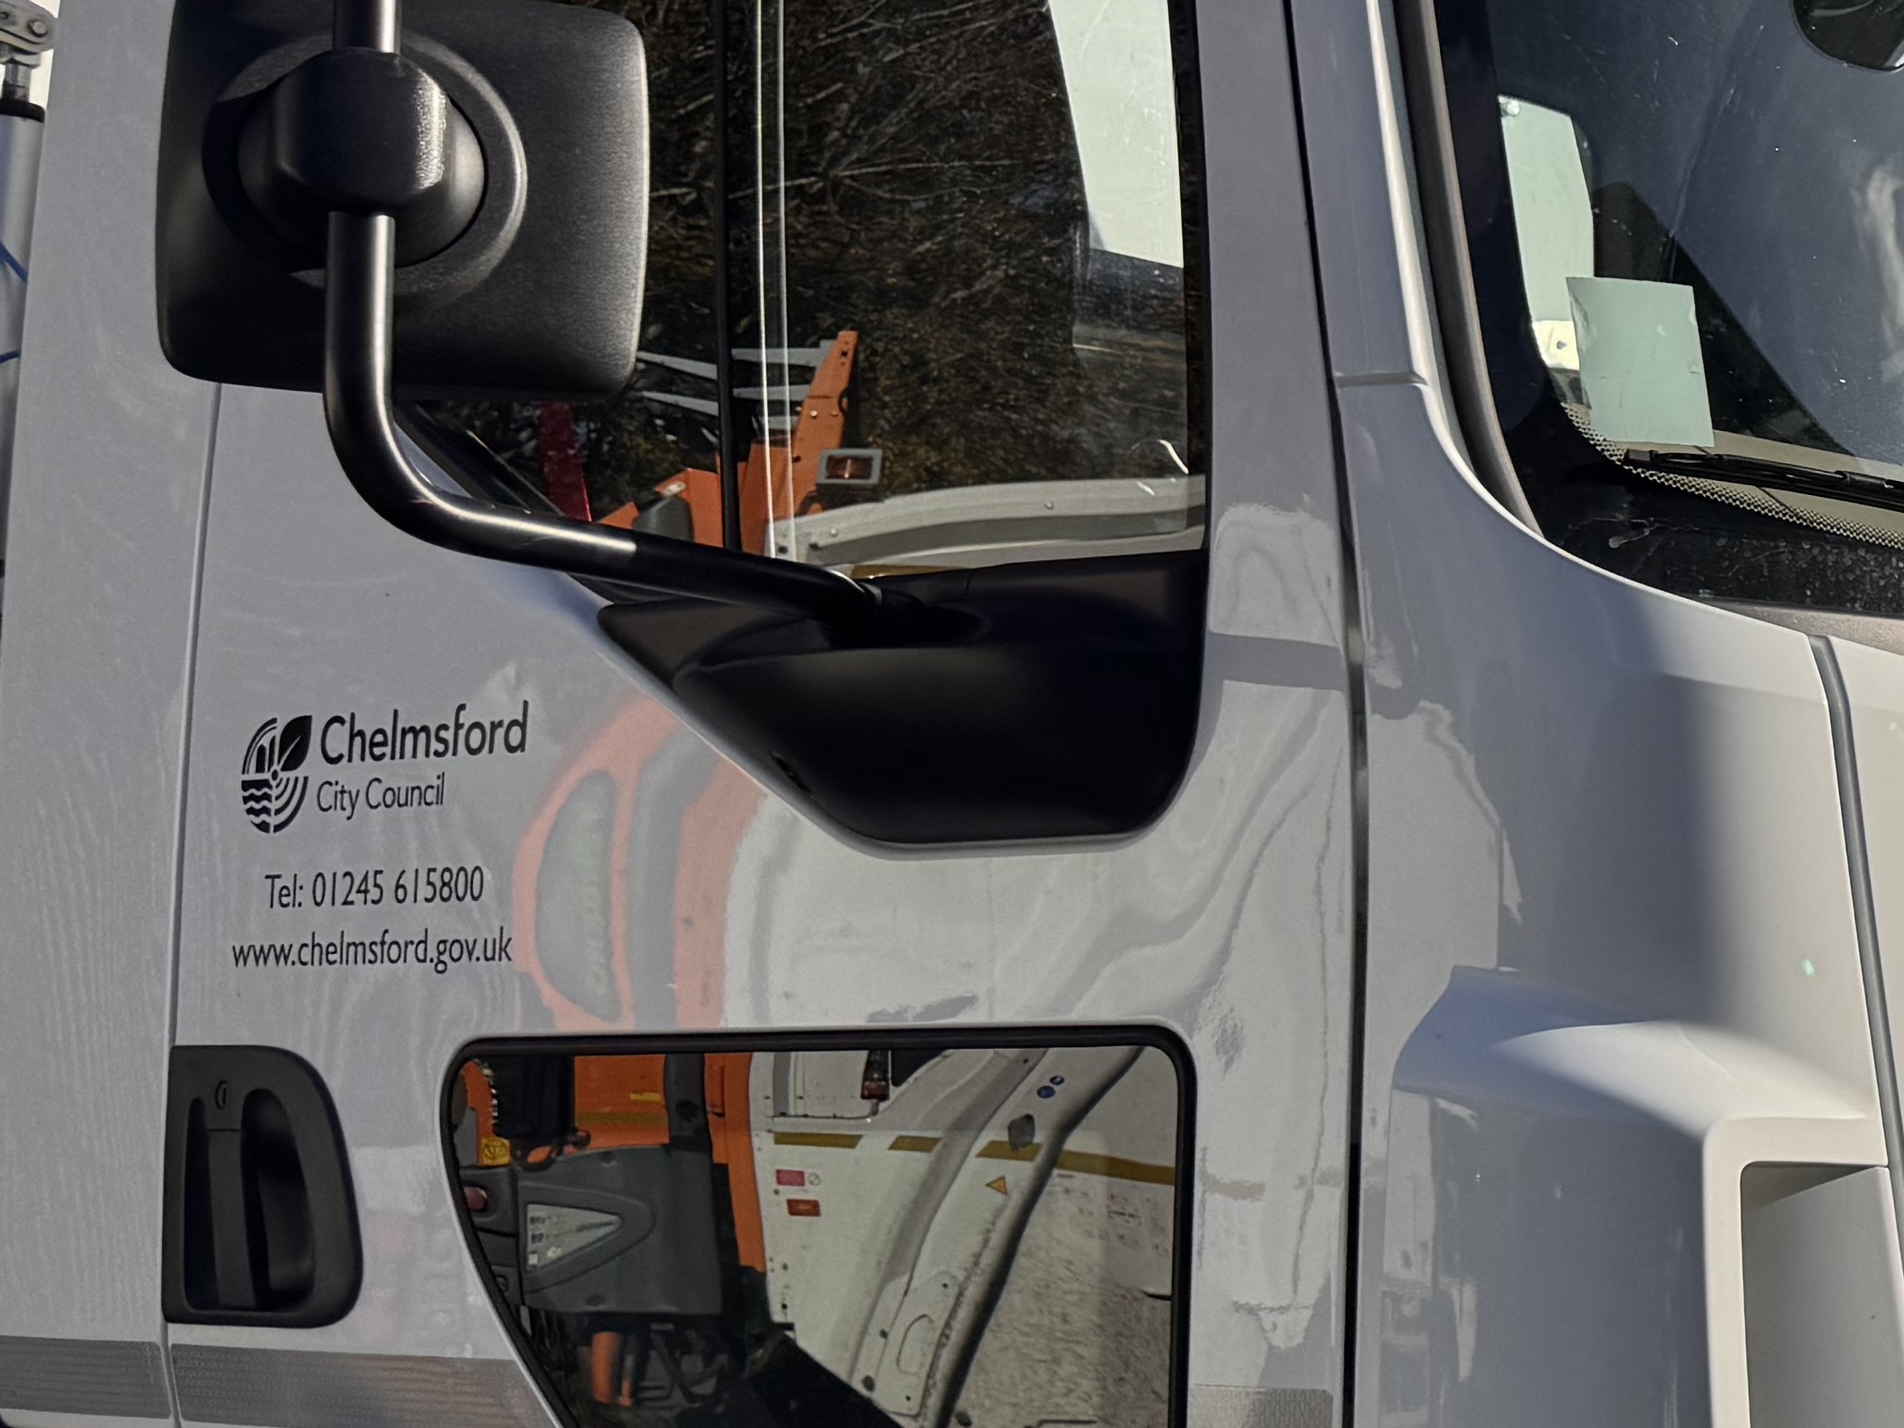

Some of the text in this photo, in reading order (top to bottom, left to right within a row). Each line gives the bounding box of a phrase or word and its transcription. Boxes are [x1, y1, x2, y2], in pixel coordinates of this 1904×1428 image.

[321, 700, 528, 765] Chelmsford
[317, 772, 444, 820] City Council
[265, 866, 483, 908] Tel: 01245 615800
[233, 926, 511, 974] www.chelmsford.gov.uk
